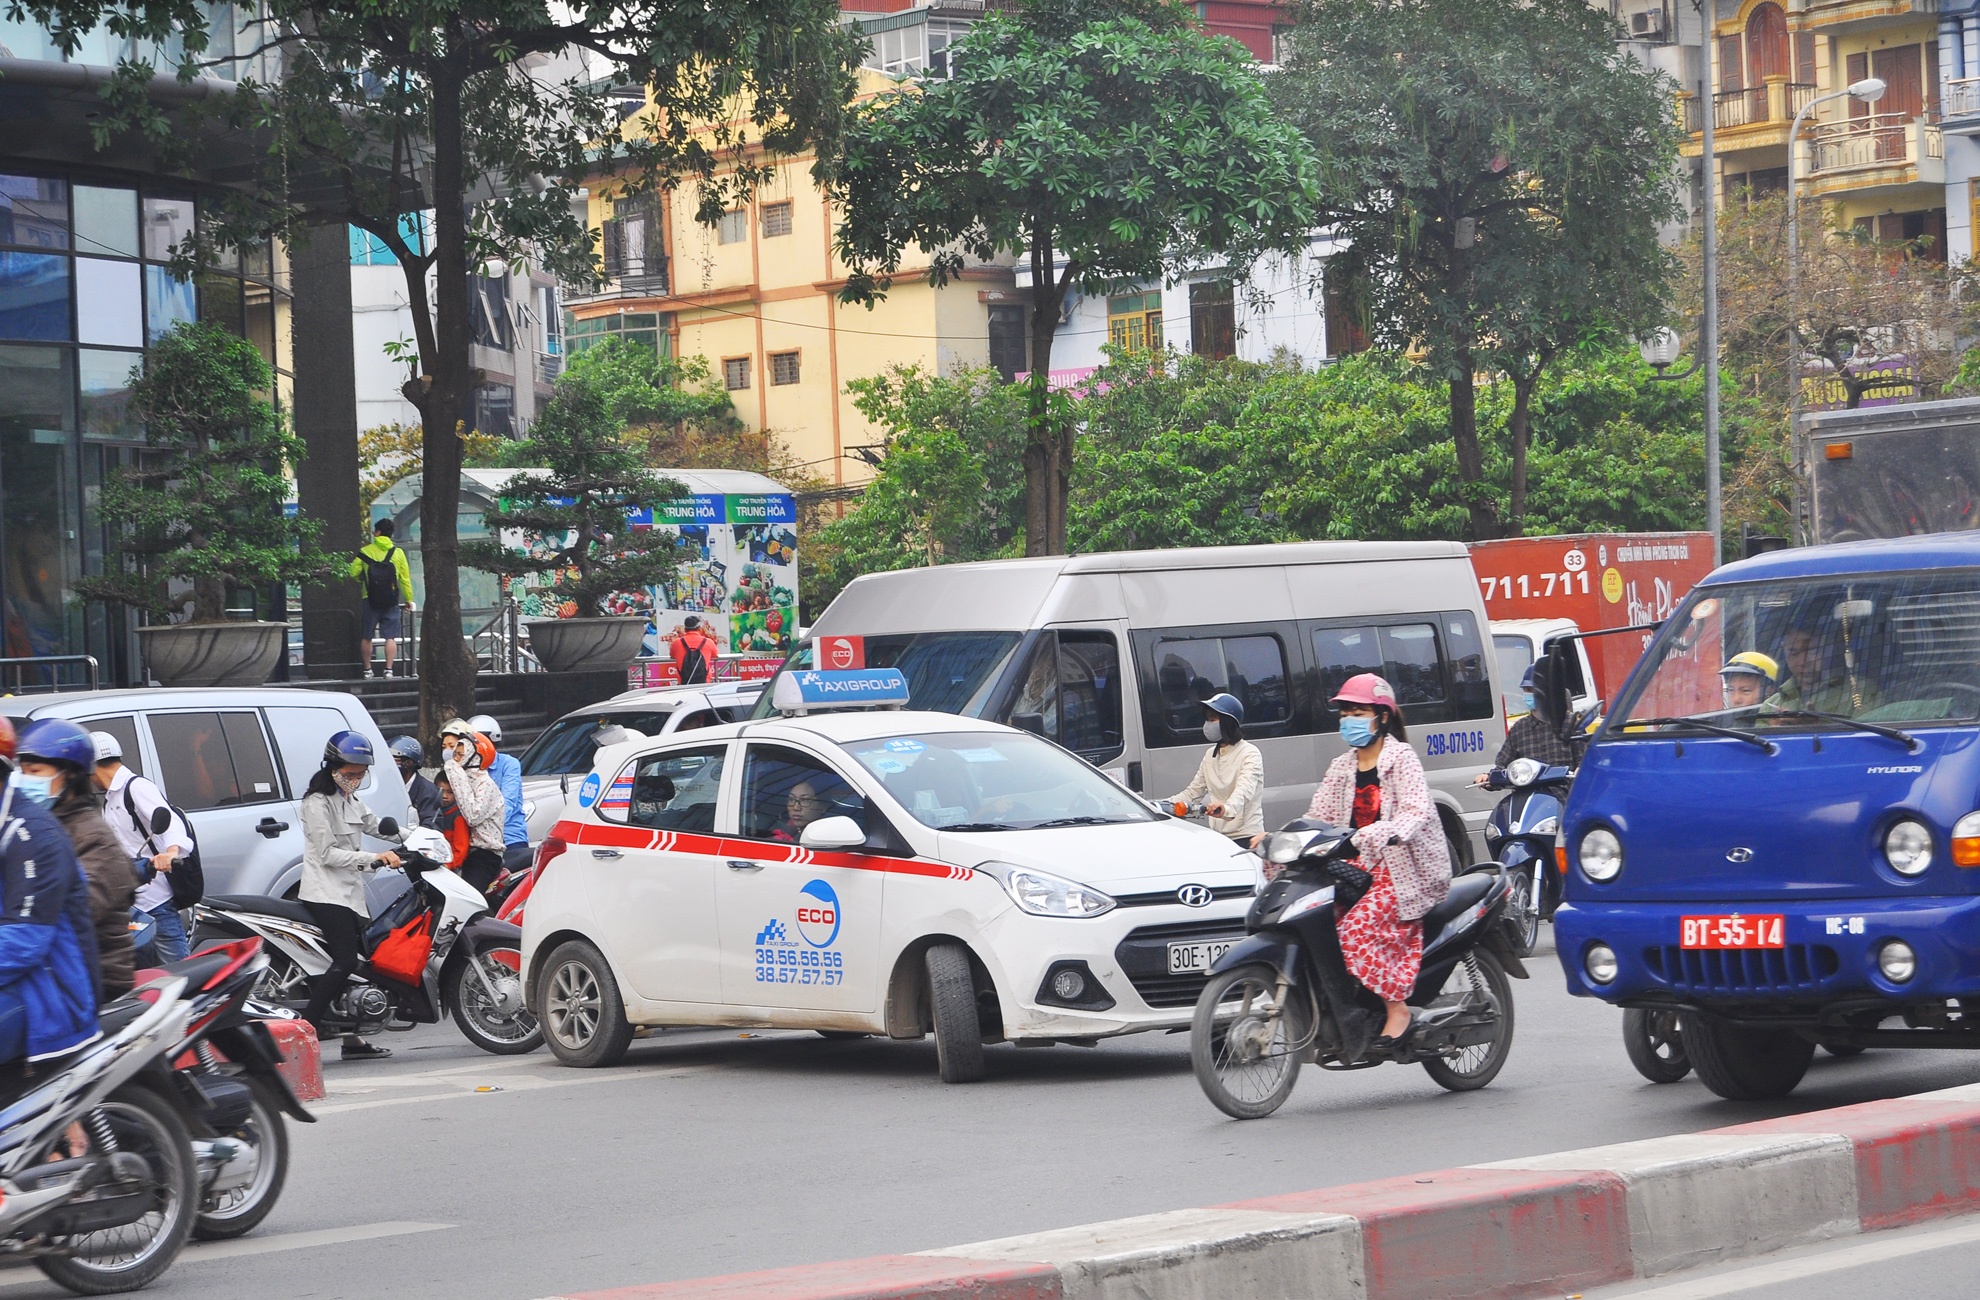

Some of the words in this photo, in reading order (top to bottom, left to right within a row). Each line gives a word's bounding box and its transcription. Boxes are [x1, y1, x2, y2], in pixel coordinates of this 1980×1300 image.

[696, 505, 715, 517] HÒA
[736, 507, 765, 516] TRUNG
[767, 505, 786, 516] HÒA
[1567, 555, 1583, 566] 33
[1480, 570, 1590, 601] 711.711
[832, 650, 851, 658] ECO
[815, 679, 901, 692] TAXIGROUP
[1867, 766, 1922, 774] HYUNDAI
[797, 908, 835, 924] ECO
[1684, 918, 1781, 946] BT-55-14
[755, 948, 843, 968] 38.56.56.56
[755, 966, 843, 986] 38.57.57.57
